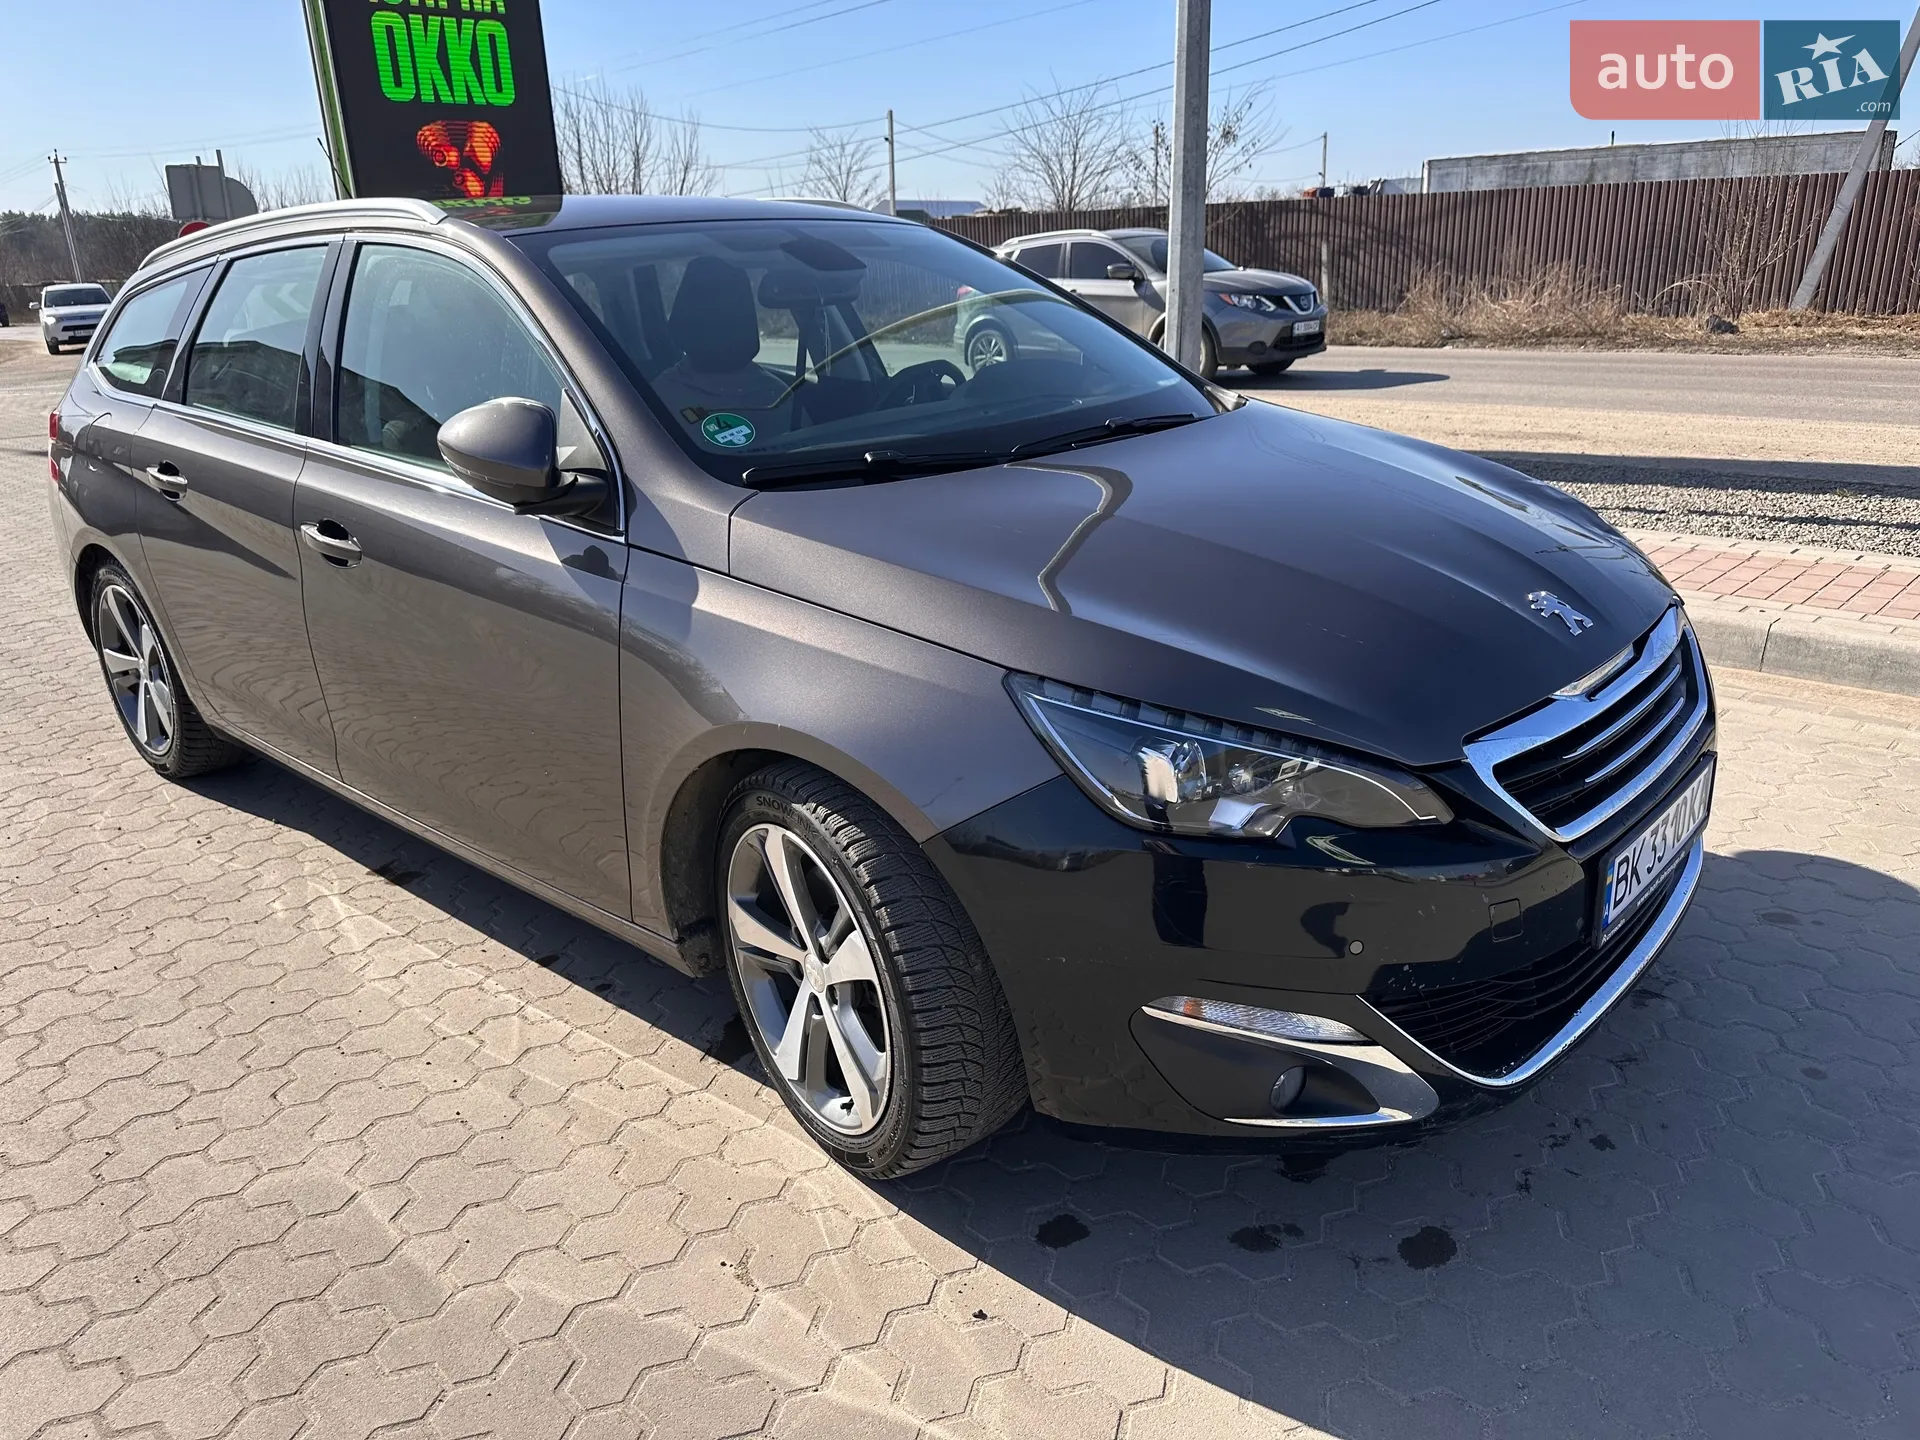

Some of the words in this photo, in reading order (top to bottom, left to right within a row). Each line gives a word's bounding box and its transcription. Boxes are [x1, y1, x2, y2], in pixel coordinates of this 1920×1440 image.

[370, 11, 516, 107] OKKO
[756, 795, 818, 839] SNOWLINK
[1613, 836, 1647, 911] BK
